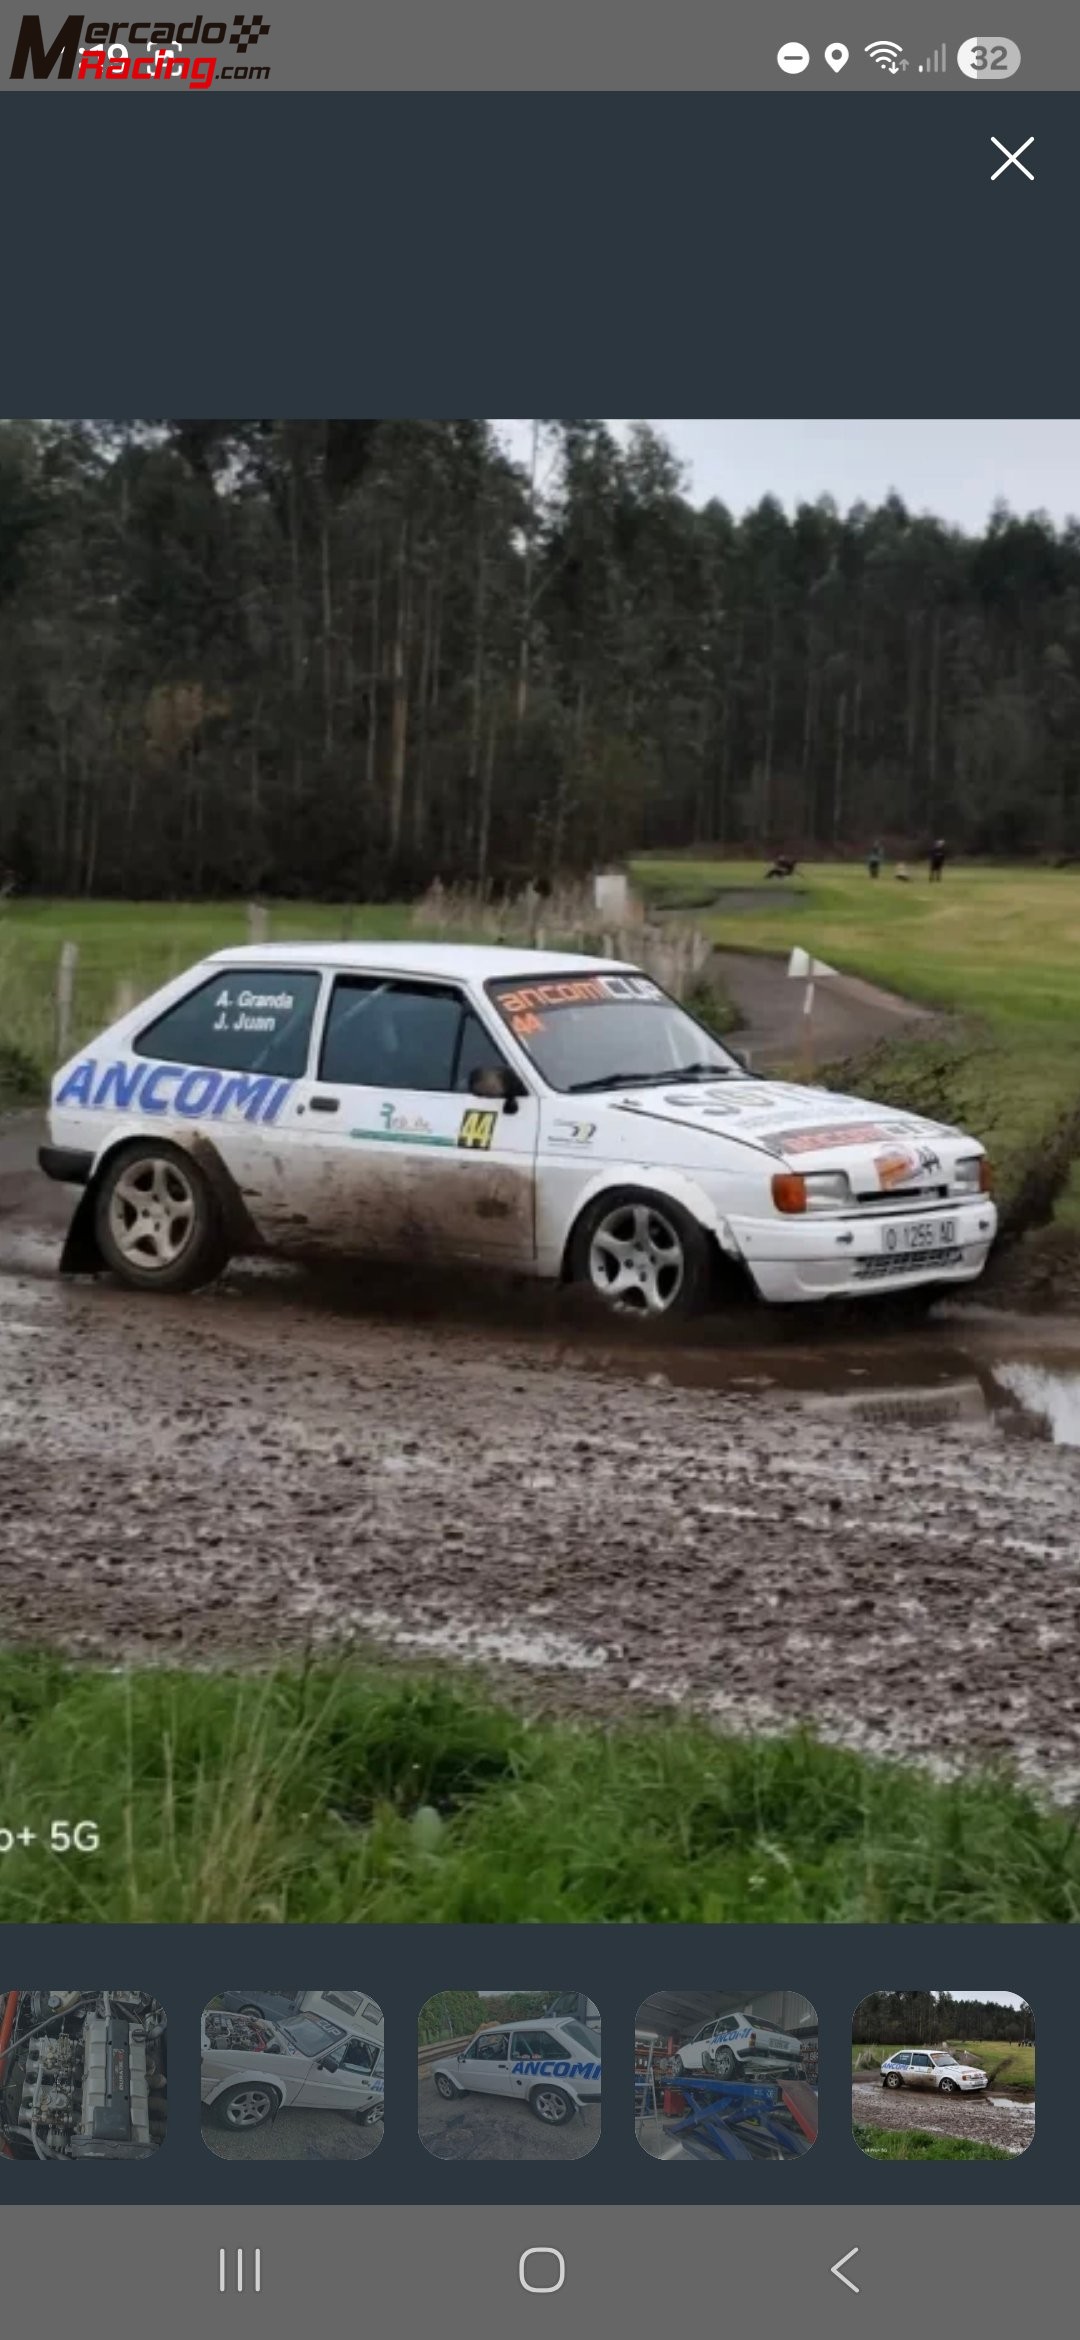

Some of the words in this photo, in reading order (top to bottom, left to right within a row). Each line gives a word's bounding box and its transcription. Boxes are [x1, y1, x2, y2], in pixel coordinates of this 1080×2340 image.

[970, 46, 1008, 71] 32
[215, 990, 232, 1007] A.
[237, 991, 294, 1009] Granda
[213, 1012, 227, 1031] J.
[233, 1013, 275, 1032] Juan
[56, 1058, 295, 1124] ANCOMI
[462, 1111, 494, 1148] 44
[512, 2061, 602, 2080] ANCOMI
